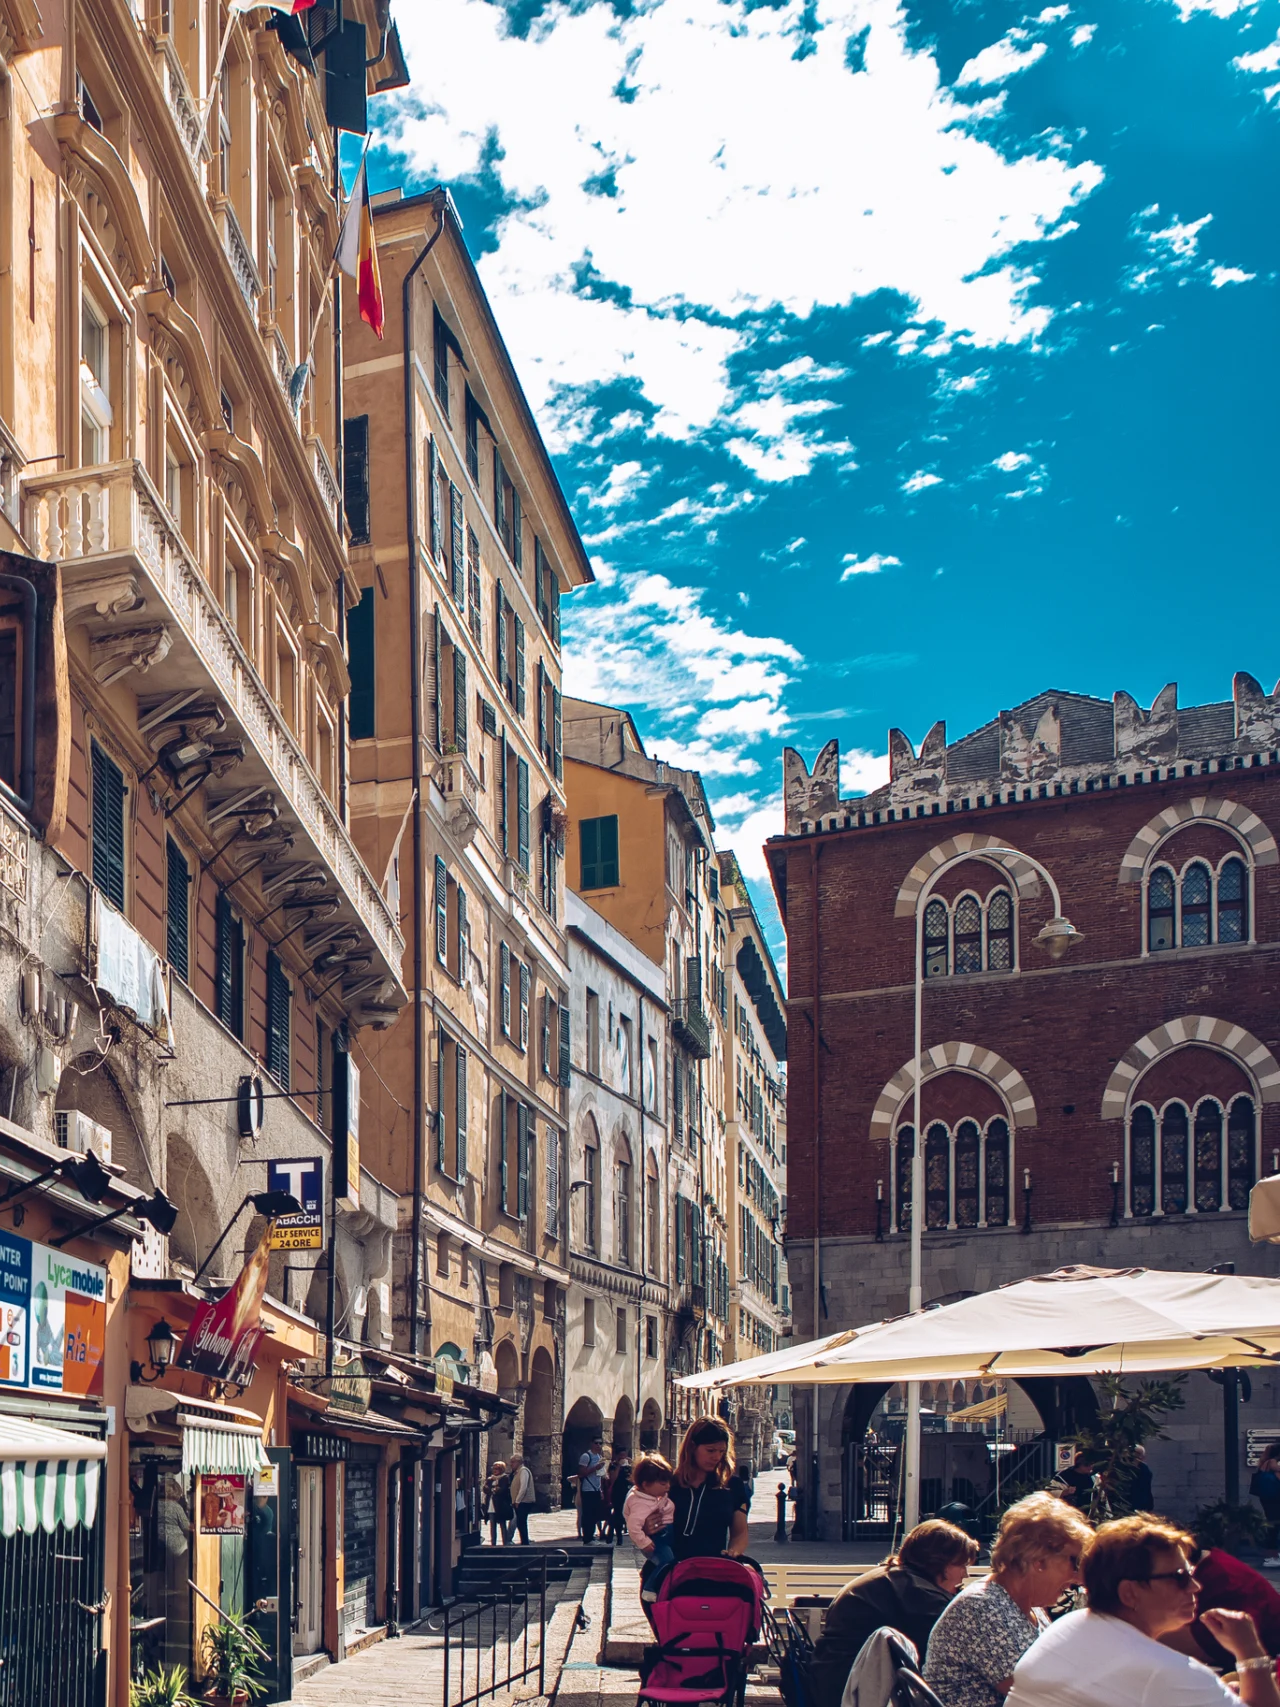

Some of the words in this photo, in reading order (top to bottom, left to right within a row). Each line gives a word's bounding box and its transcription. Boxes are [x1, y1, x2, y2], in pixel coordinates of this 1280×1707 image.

[275, 1161, 315, 1206] T
[279, 1239, 291, 1248] 24
[292, 1238, 312, 1247] ORE
[289, 1228, 320, 1238] SERVICE
[3, 1270, 29, 1295] POINT
[47, 1253, 104, 1298] Lycamobile
[66, 1331, 87, 1363] Ria
